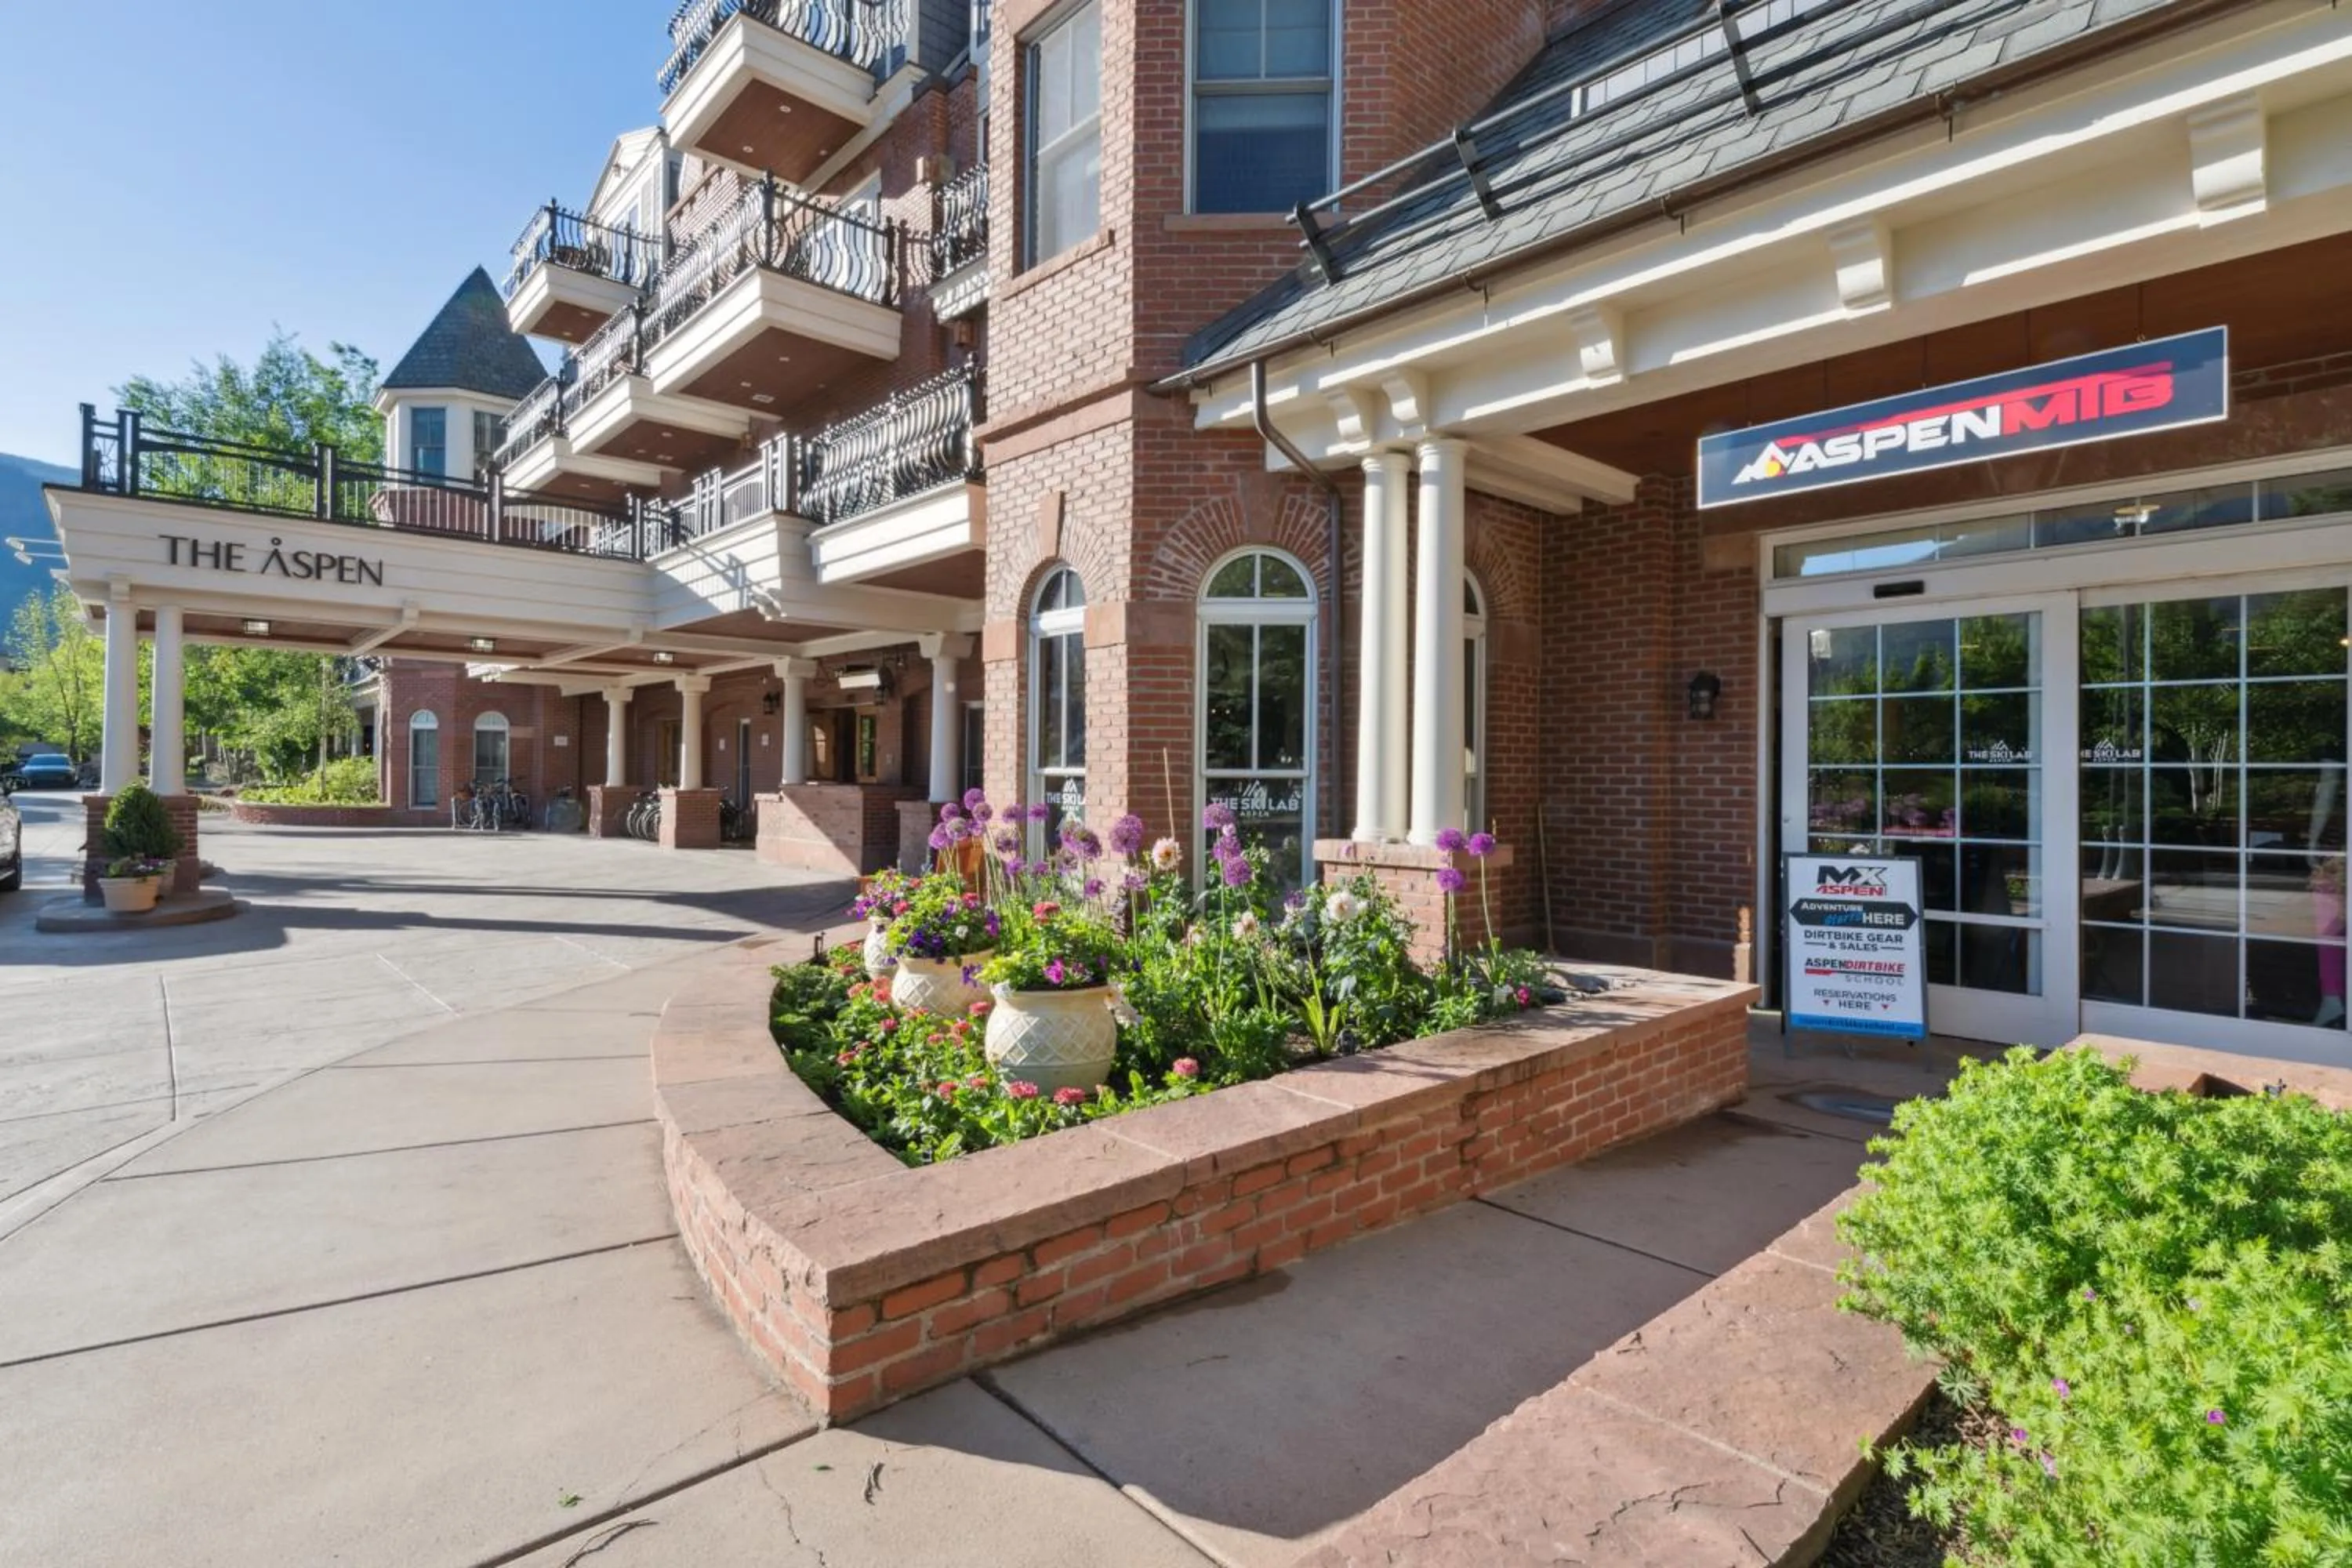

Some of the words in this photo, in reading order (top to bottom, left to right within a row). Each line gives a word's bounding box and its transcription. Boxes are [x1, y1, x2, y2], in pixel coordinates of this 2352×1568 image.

[1787, 373, 2174, 474] ASPENMTB
[158, 535, 247, 572] THE
[1968, 750, 1988, 759] THE
[2116, 749, 2141, 758] LAB
[1269, 797, 1299, 812] LAB
[1817, 866, 1888, 886] MX
[1816, 885, 1883, 896] ASPEN
[1862, 913, 1905, 925] HERE
[1804, 930, 1864, 941] DIRTBIKE
[1867, 933, 1904, 944] GEAR
[1839, 942, 1878, 952] SALES
[1845, 975, 1904, 986] SCHOOL
[1813, 989, 1897, 1003] RESERVATIONS
[1838, 1000, 1871, 1011] HERE
